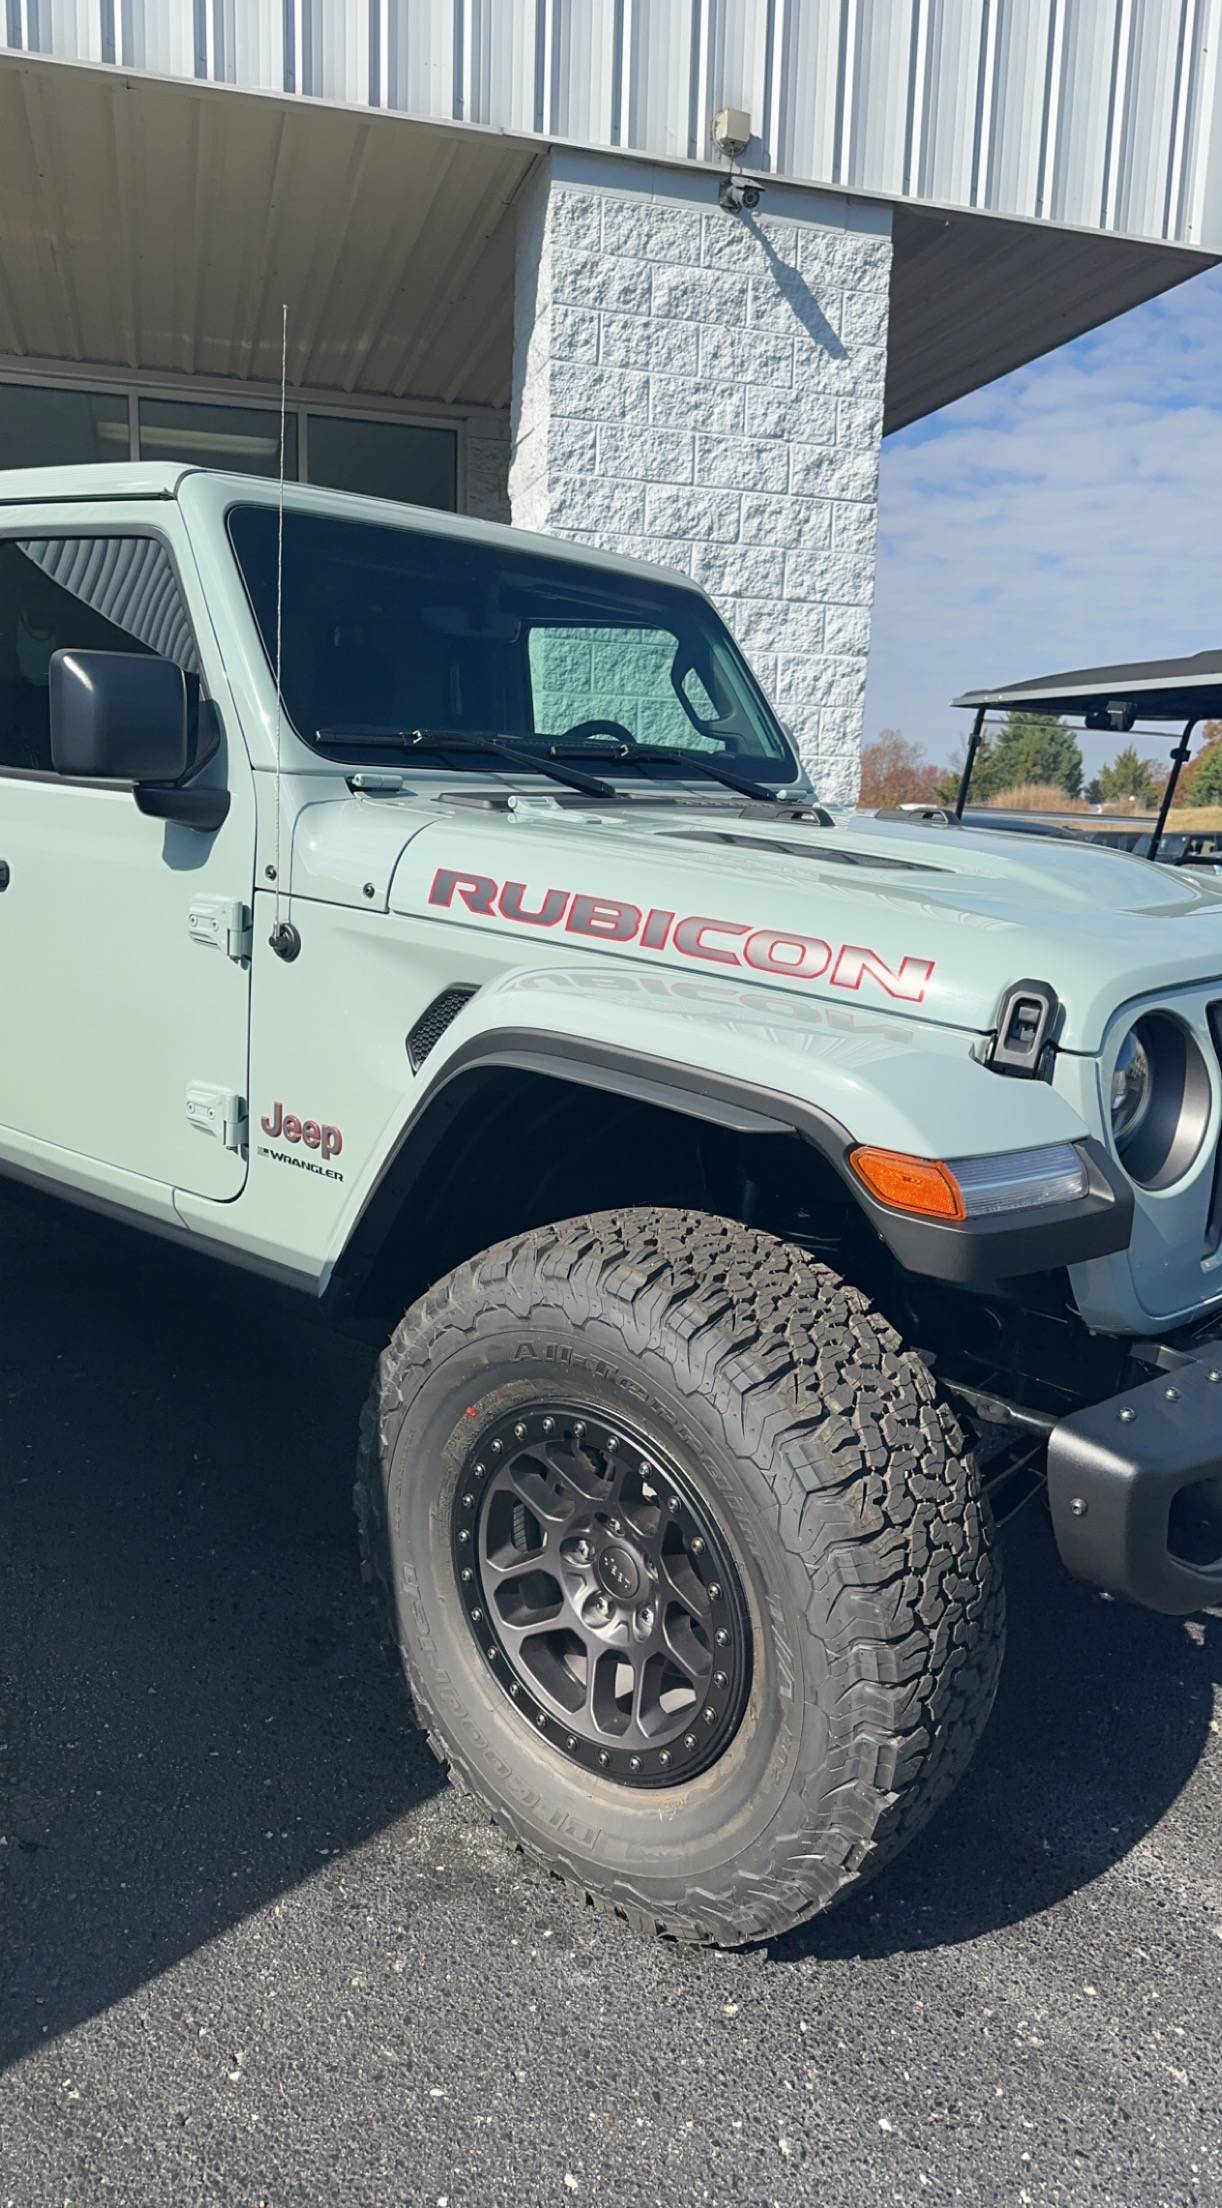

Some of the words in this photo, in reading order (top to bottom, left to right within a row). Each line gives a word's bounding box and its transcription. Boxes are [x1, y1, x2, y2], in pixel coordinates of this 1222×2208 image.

[428, 868, 935, 1003] RUBICON
[261, 1101, 342, 1161] Jeep
[270, 1150, 344, 1182] WRANGLER
